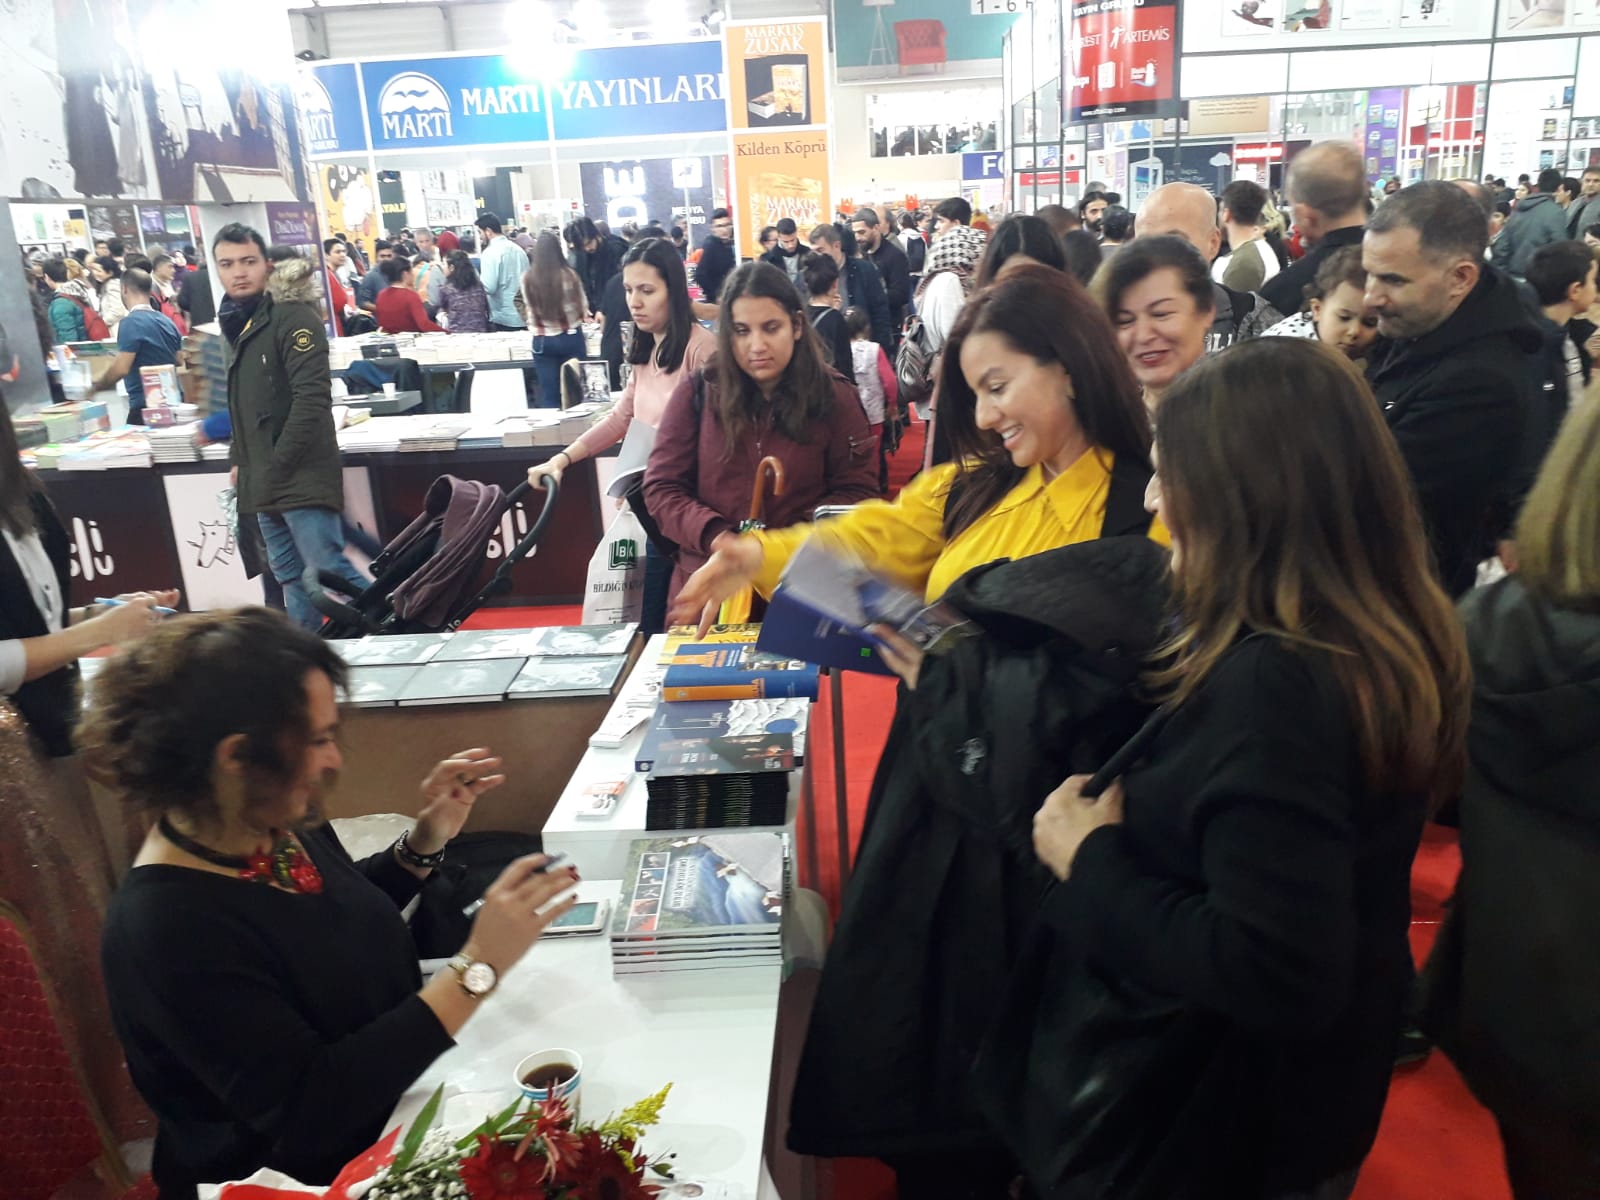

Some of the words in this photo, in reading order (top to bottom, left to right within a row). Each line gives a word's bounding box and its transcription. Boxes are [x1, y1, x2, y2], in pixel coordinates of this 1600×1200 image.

[744, 23, 804, 39] MARKUS
[744, 36, 804, 54] ZUSAK
[460, 84, 540, 116] MARTI
[556, 72, 725, 110] YAYINLARI
[381, 112, 454, 140] MARTI
[737, 141, 780, 157] Kilden
[784, 139, 827, 159] Köprü
